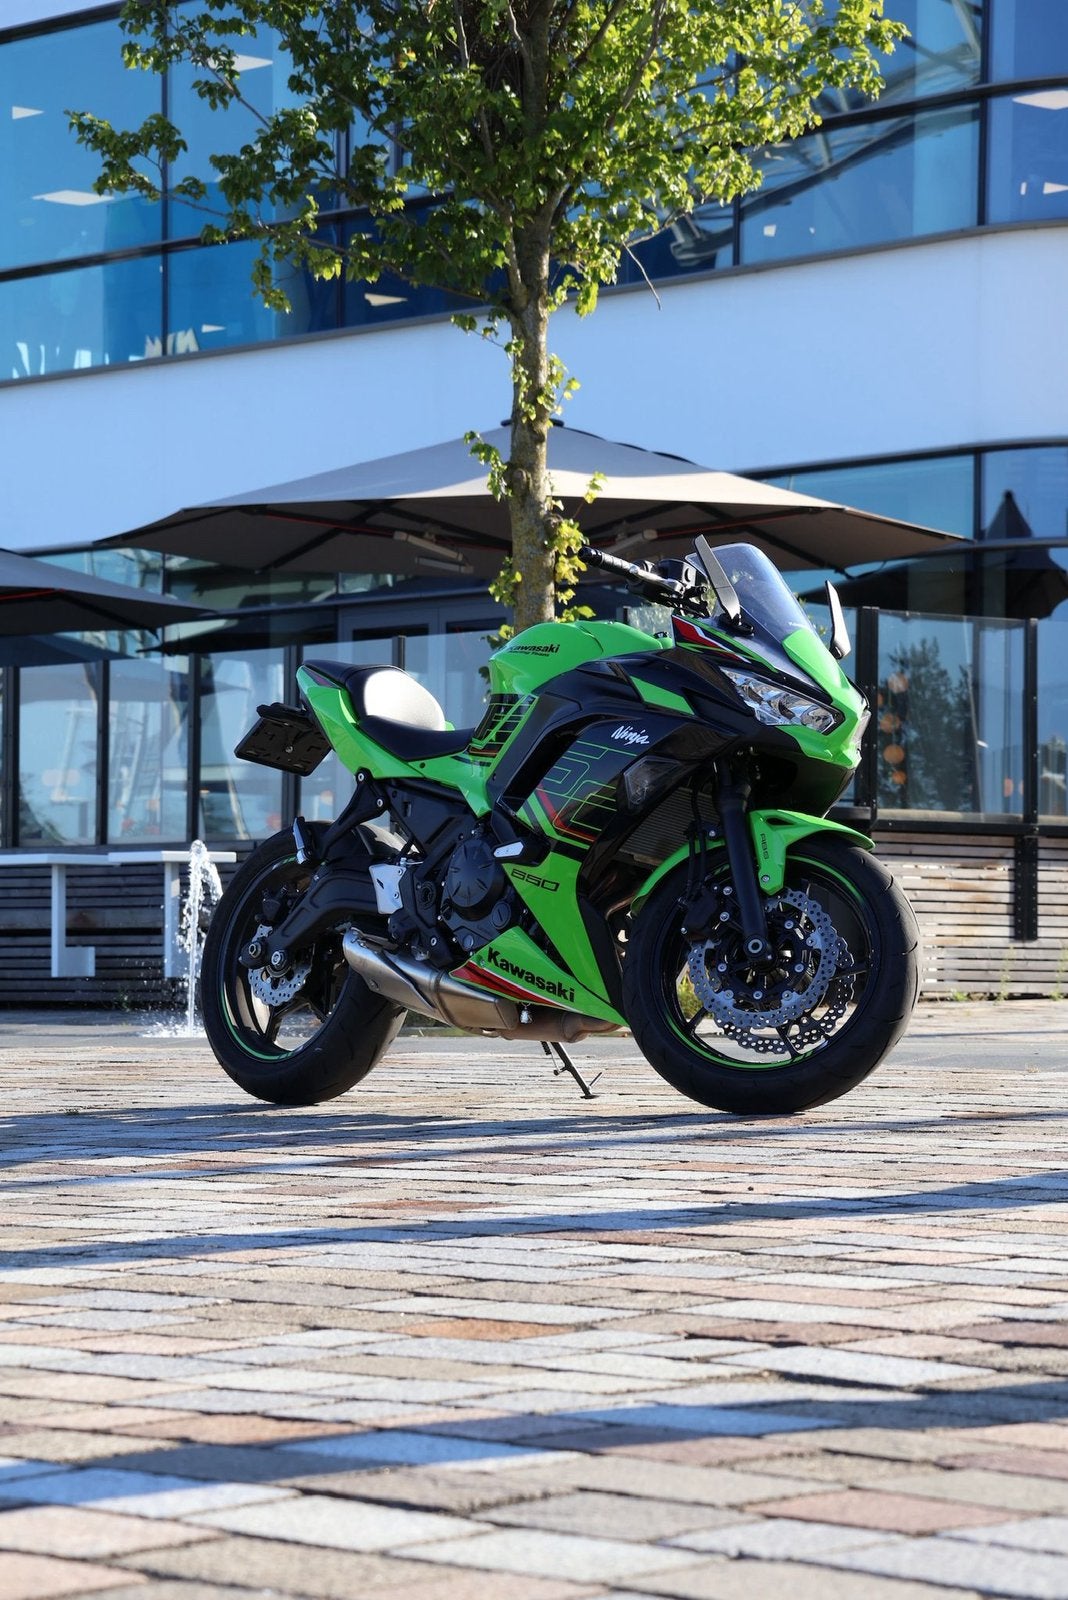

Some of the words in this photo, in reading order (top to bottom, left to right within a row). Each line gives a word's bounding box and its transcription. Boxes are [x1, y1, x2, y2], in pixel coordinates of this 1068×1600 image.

[611, 725, 650, 746] Ninja
[511, 868, 560, 892] 650
[487, 946, 575, 1003] Kawasaki
